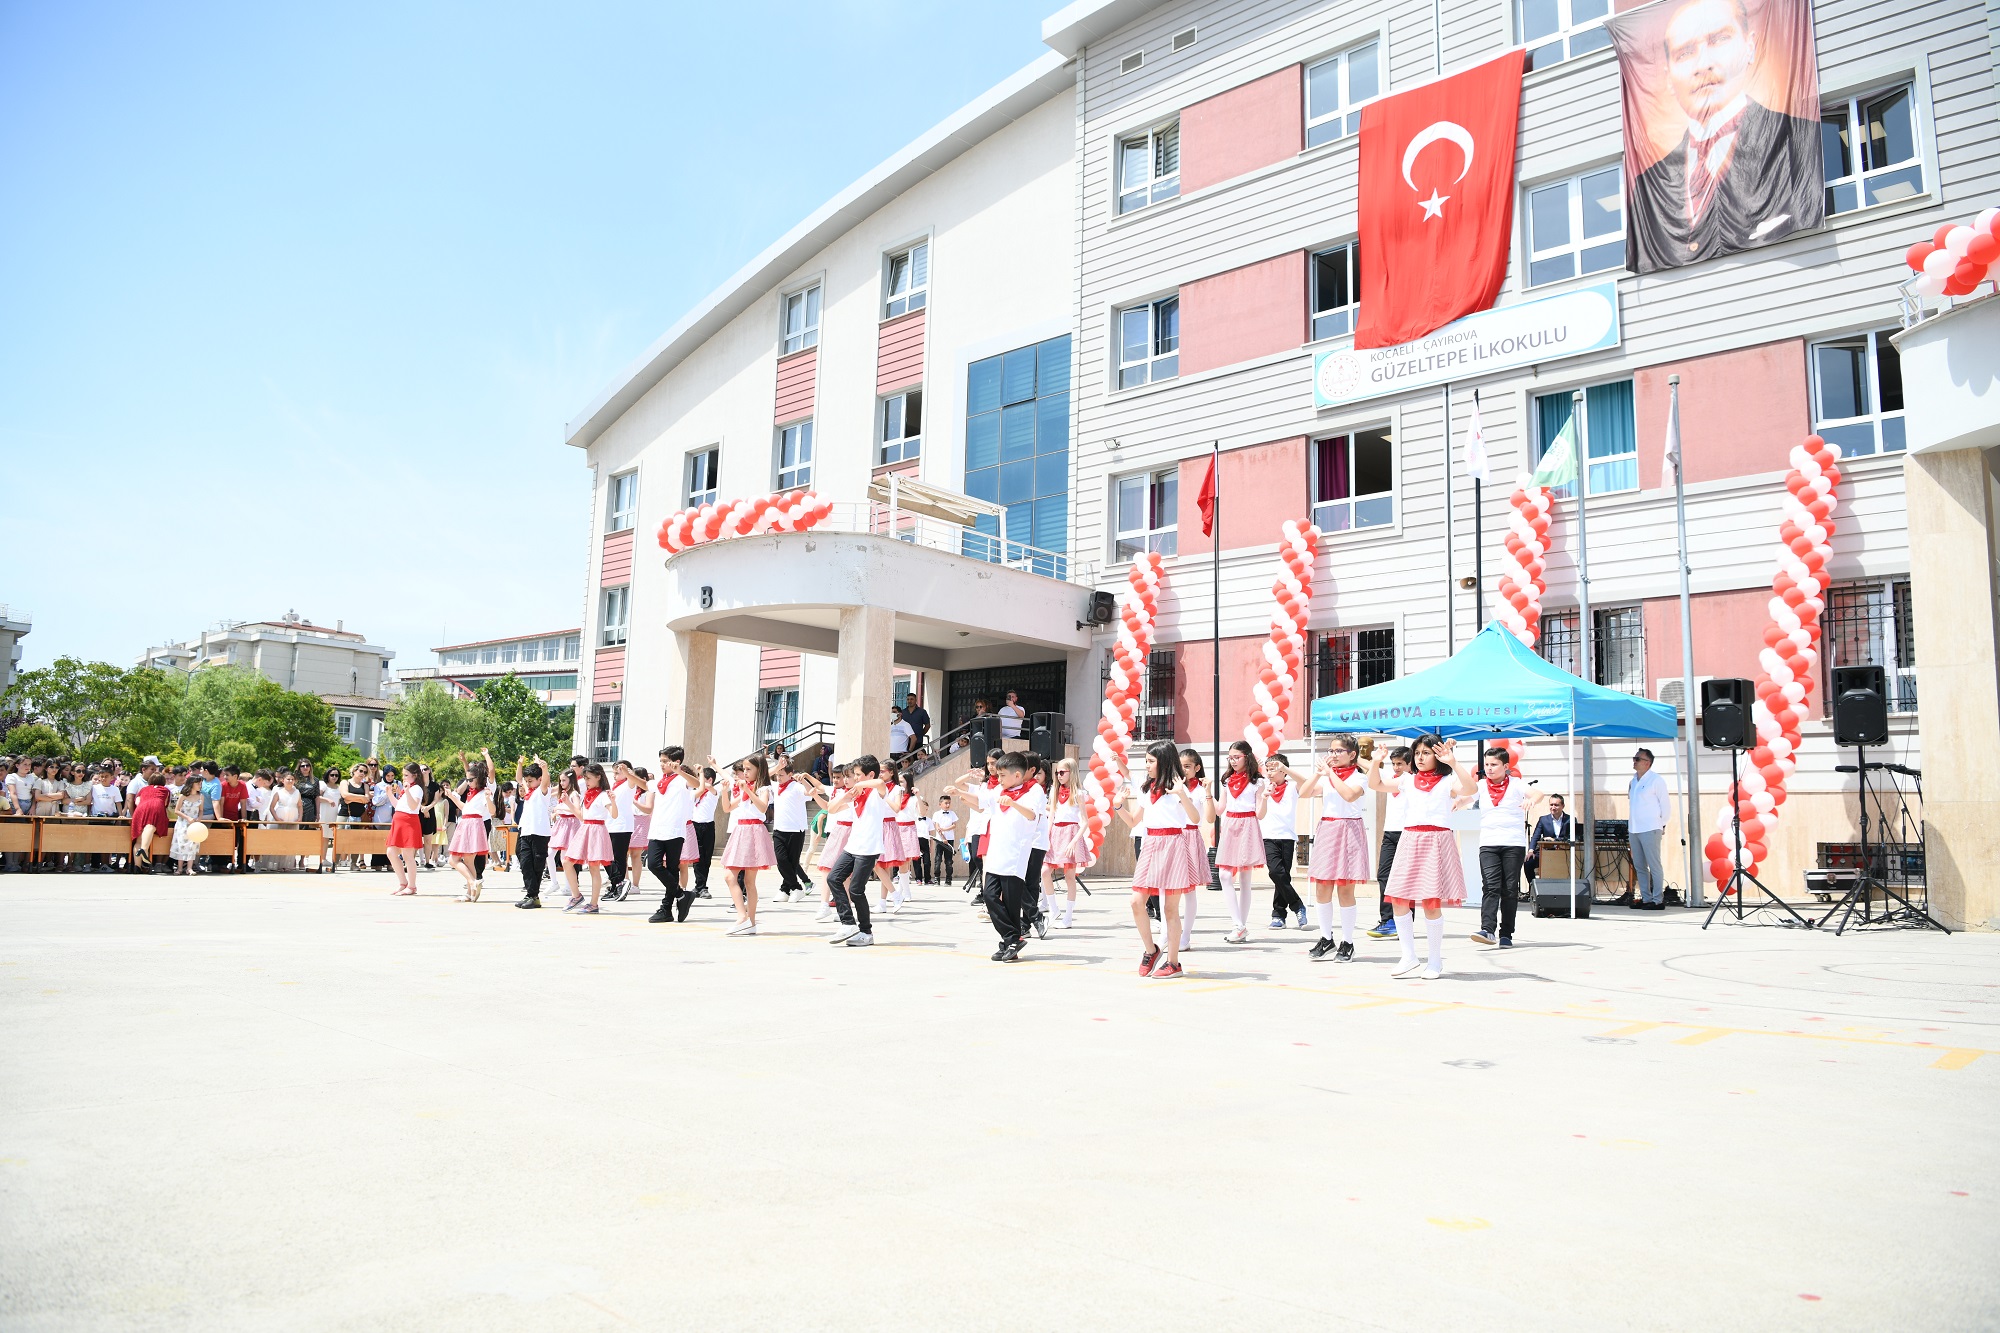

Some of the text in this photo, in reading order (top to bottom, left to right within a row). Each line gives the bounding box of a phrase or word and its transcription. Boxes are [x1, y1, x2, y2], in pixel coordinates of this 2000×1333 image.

[1370, 342, 1415, 362] KOCAELİ
[1423, 329, 1478, 352] ÇAYIROVA
[1371, 325, 1567, 382] GÜZELTEPE İLKOKULU
[700, 585, 714, 609] B
[1340, 705, 1517, 723] ÇAYIROVA BELEDİYESİ
